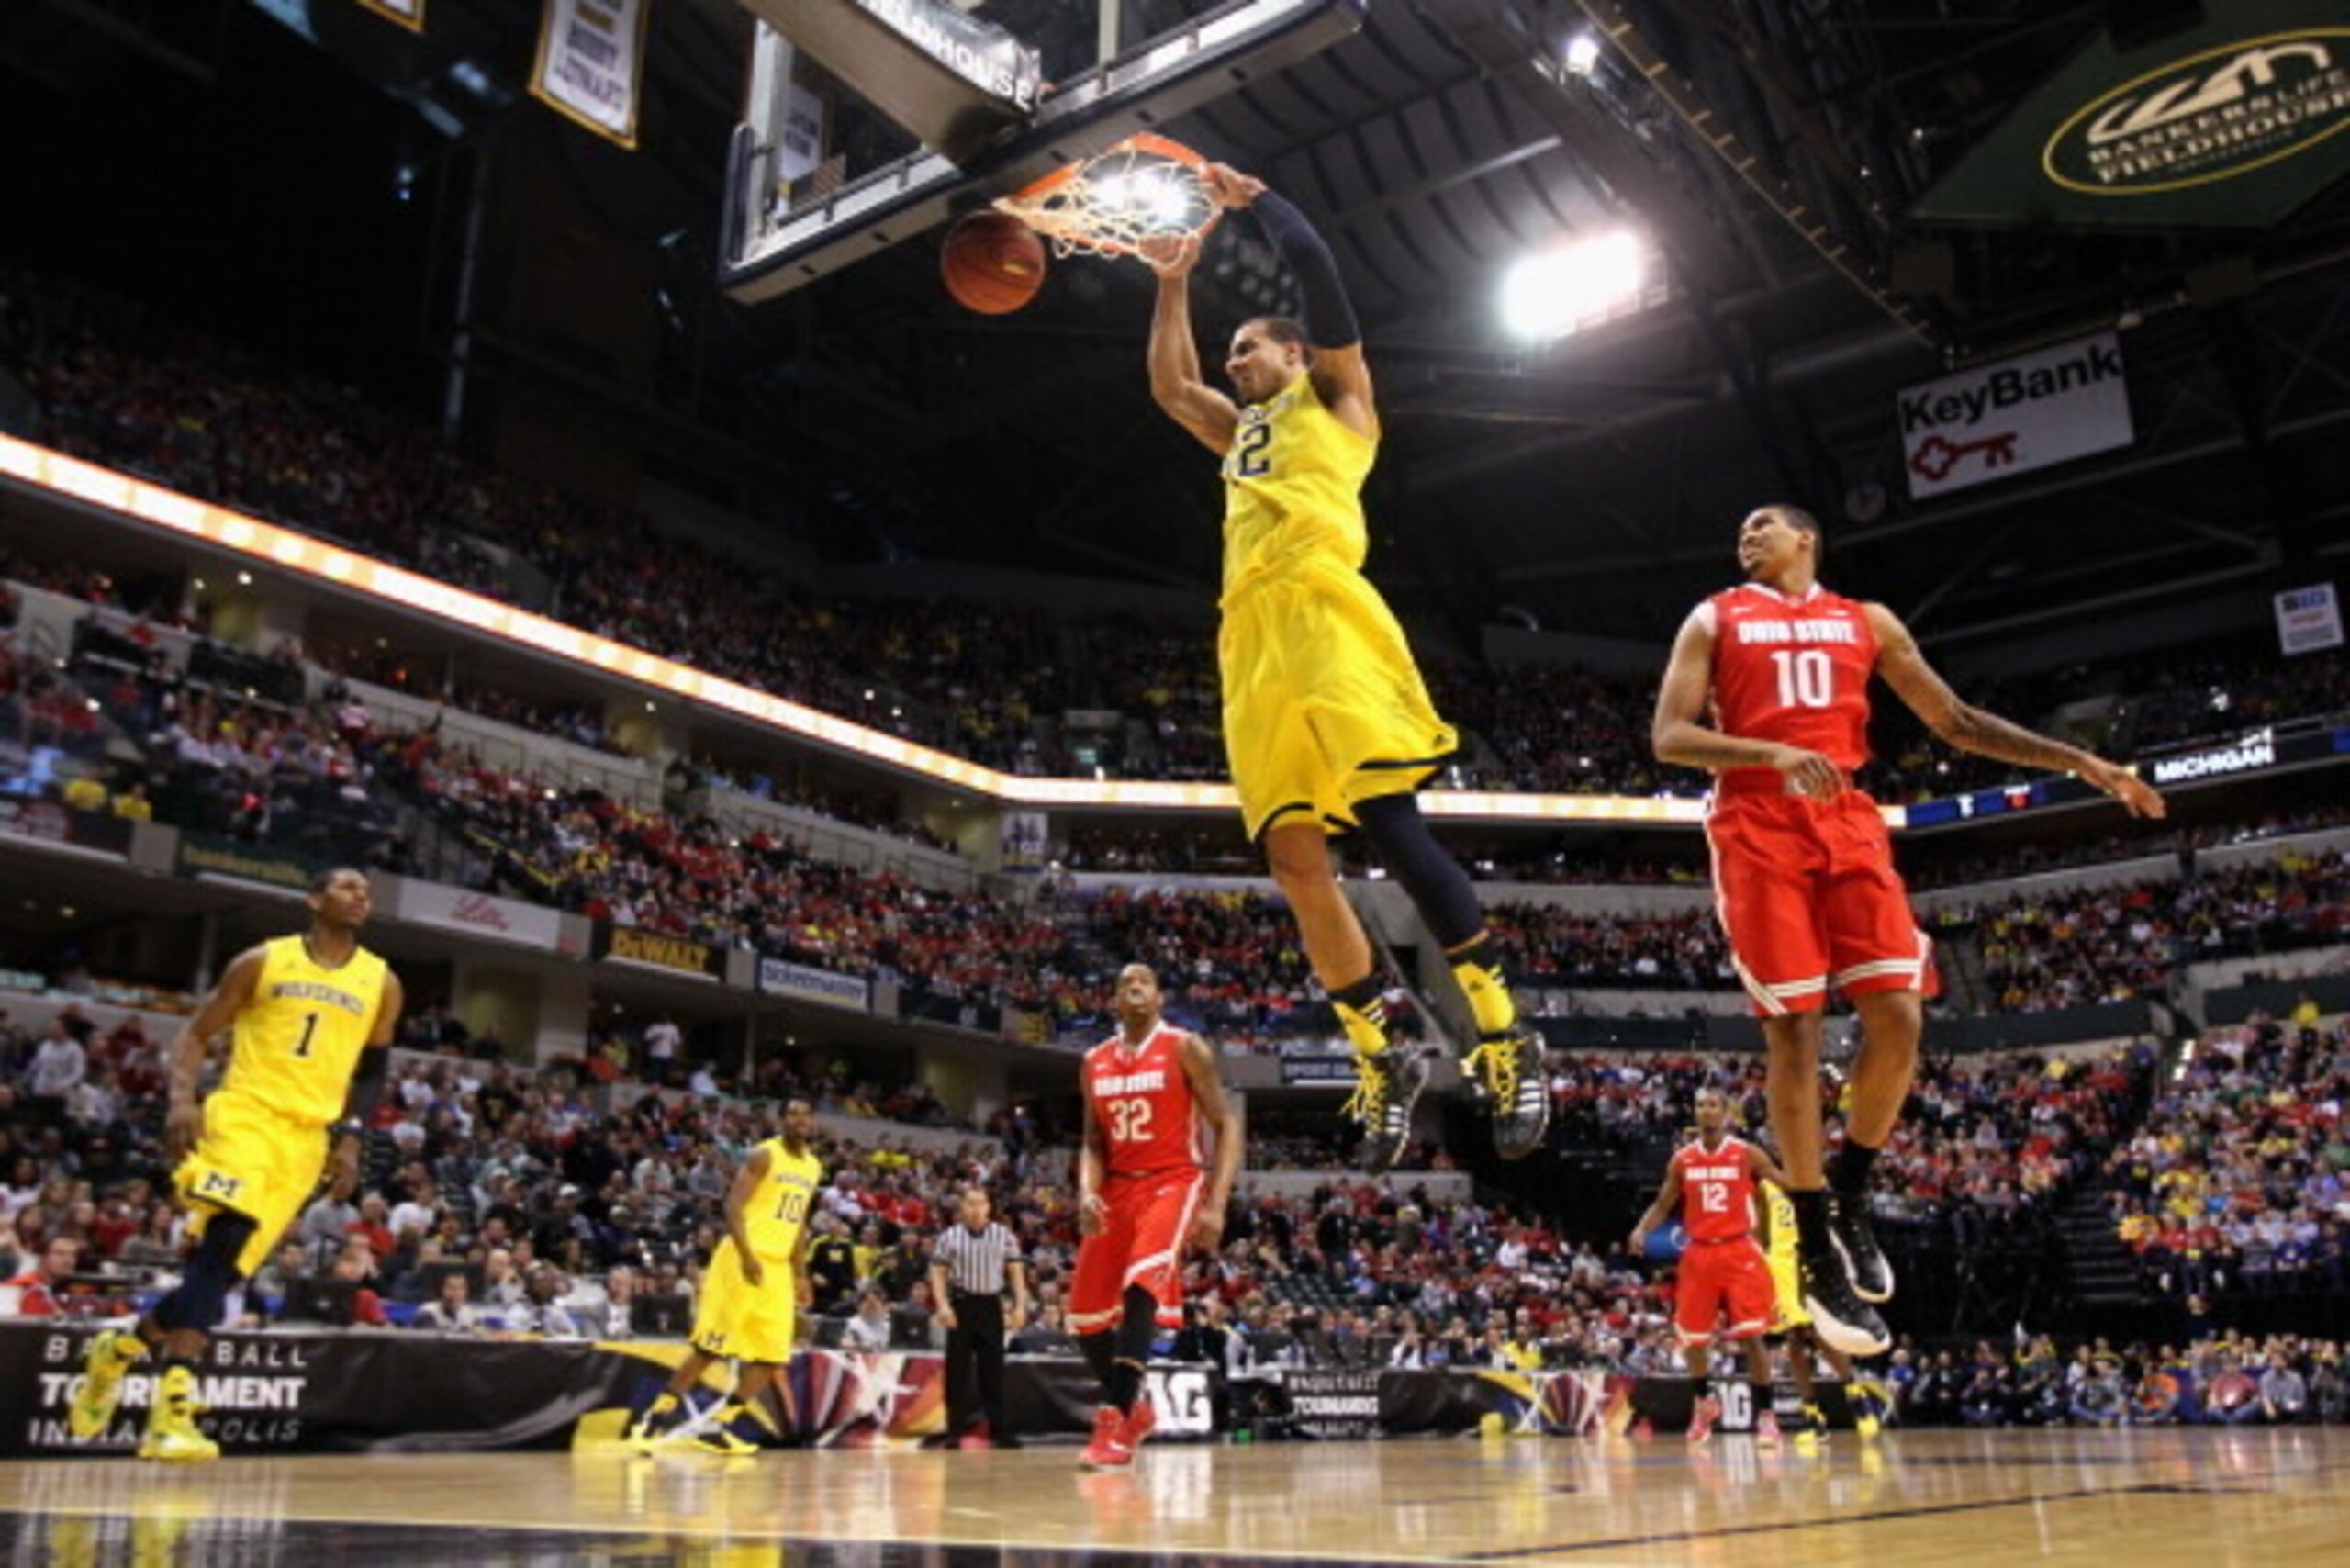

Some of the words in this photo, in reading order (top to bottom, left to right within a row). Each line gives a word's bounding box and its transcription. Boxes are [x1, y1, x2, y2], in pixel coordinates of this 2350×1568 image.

[1901, 344, 2122, 434] KeyBank
[1234, 423, 1271, 476] 2
[1794, 618, 1858, 644] STATE
[1770, 649, 1832, 708] 10
[2154, 744, 2274, 782] MICHIGAN
[296, 1011, 318, 1057] 1
[1107, 1098, 1154, 1141] 32
[776, 1192, 804, 1223] 10
[1701, 1182, 1729, 1212] 12
